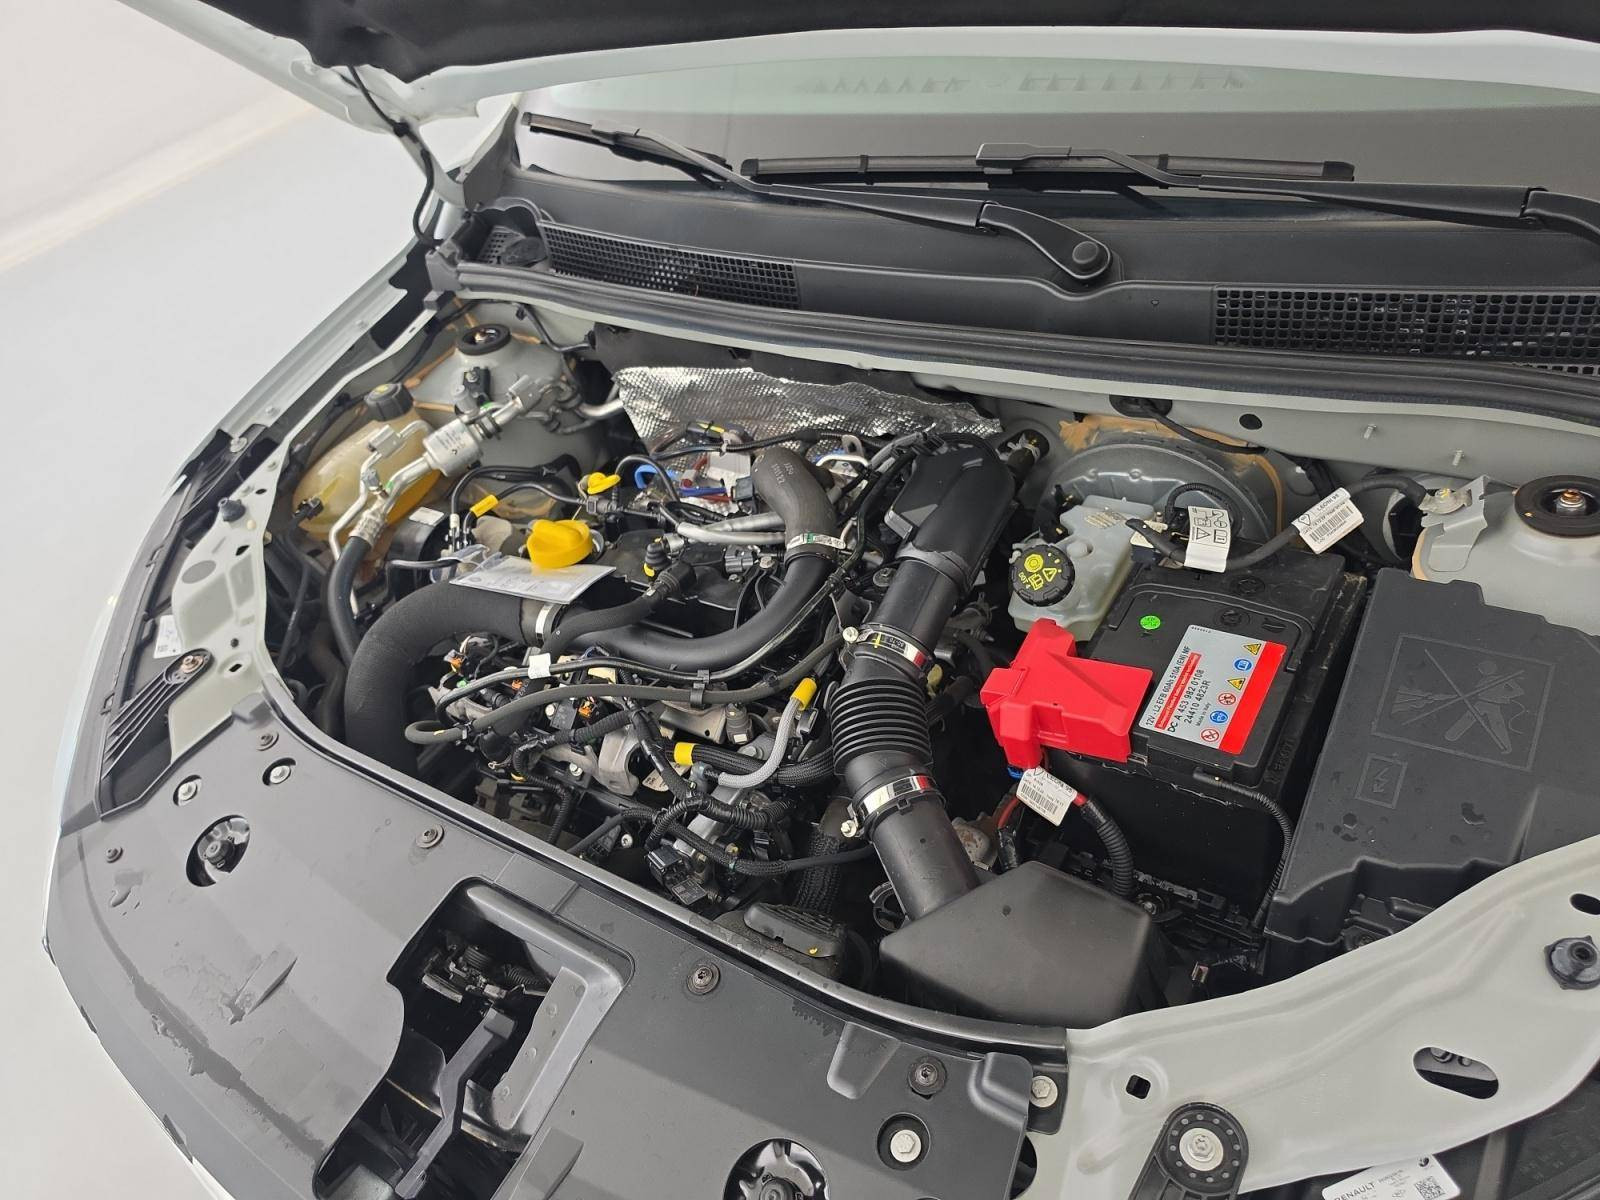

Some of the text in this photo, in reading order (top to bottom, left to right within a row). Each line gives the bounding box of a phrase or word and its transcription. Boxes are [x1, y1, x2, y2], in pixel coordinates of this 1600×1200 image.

[1018, 571, 1029, 584] DOT
[1146, 714, 1155, 726] 12V
[1156, 692, 1167, 705] EFB
[1178, 700, 1189, 713] 453
[1184, 686, 1196, 699] 982
[1184, 702, 1199, 724] 24410
